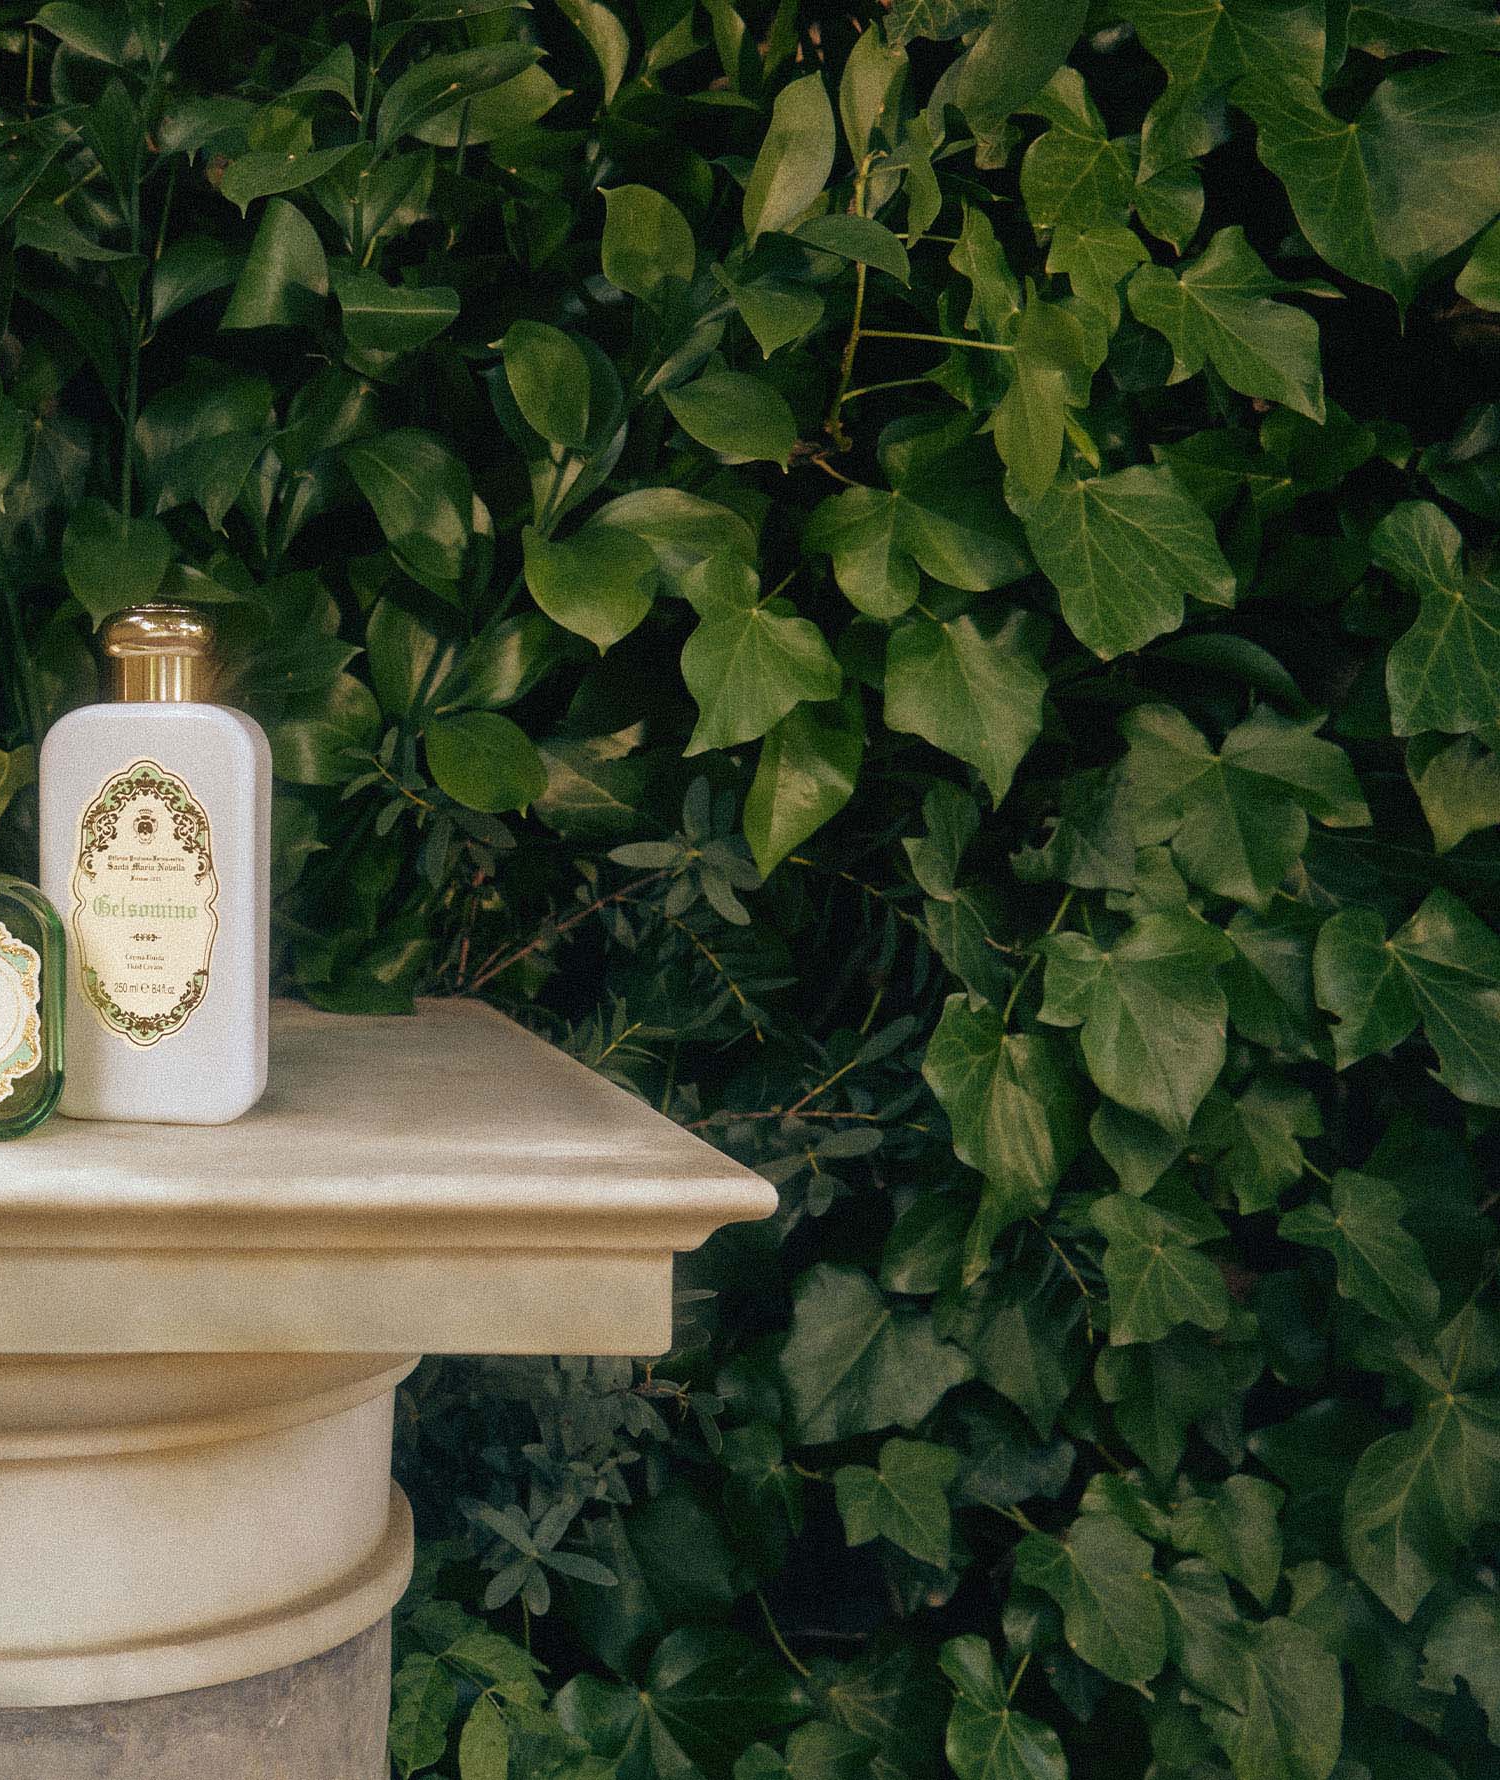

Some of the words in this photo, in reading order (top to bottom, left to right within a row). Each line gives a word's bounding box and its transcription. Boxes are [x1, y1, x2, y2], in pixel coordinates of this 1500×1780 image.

[107, 862, 129, 871] Santa
[132, 862, 154, 871] Maria
[157, 862, 185, 872] Novella
[93, 894, 197, 919] Gelsomino
[114, 982, 127, 993] 250
[130, 983, 138, 993] ml
